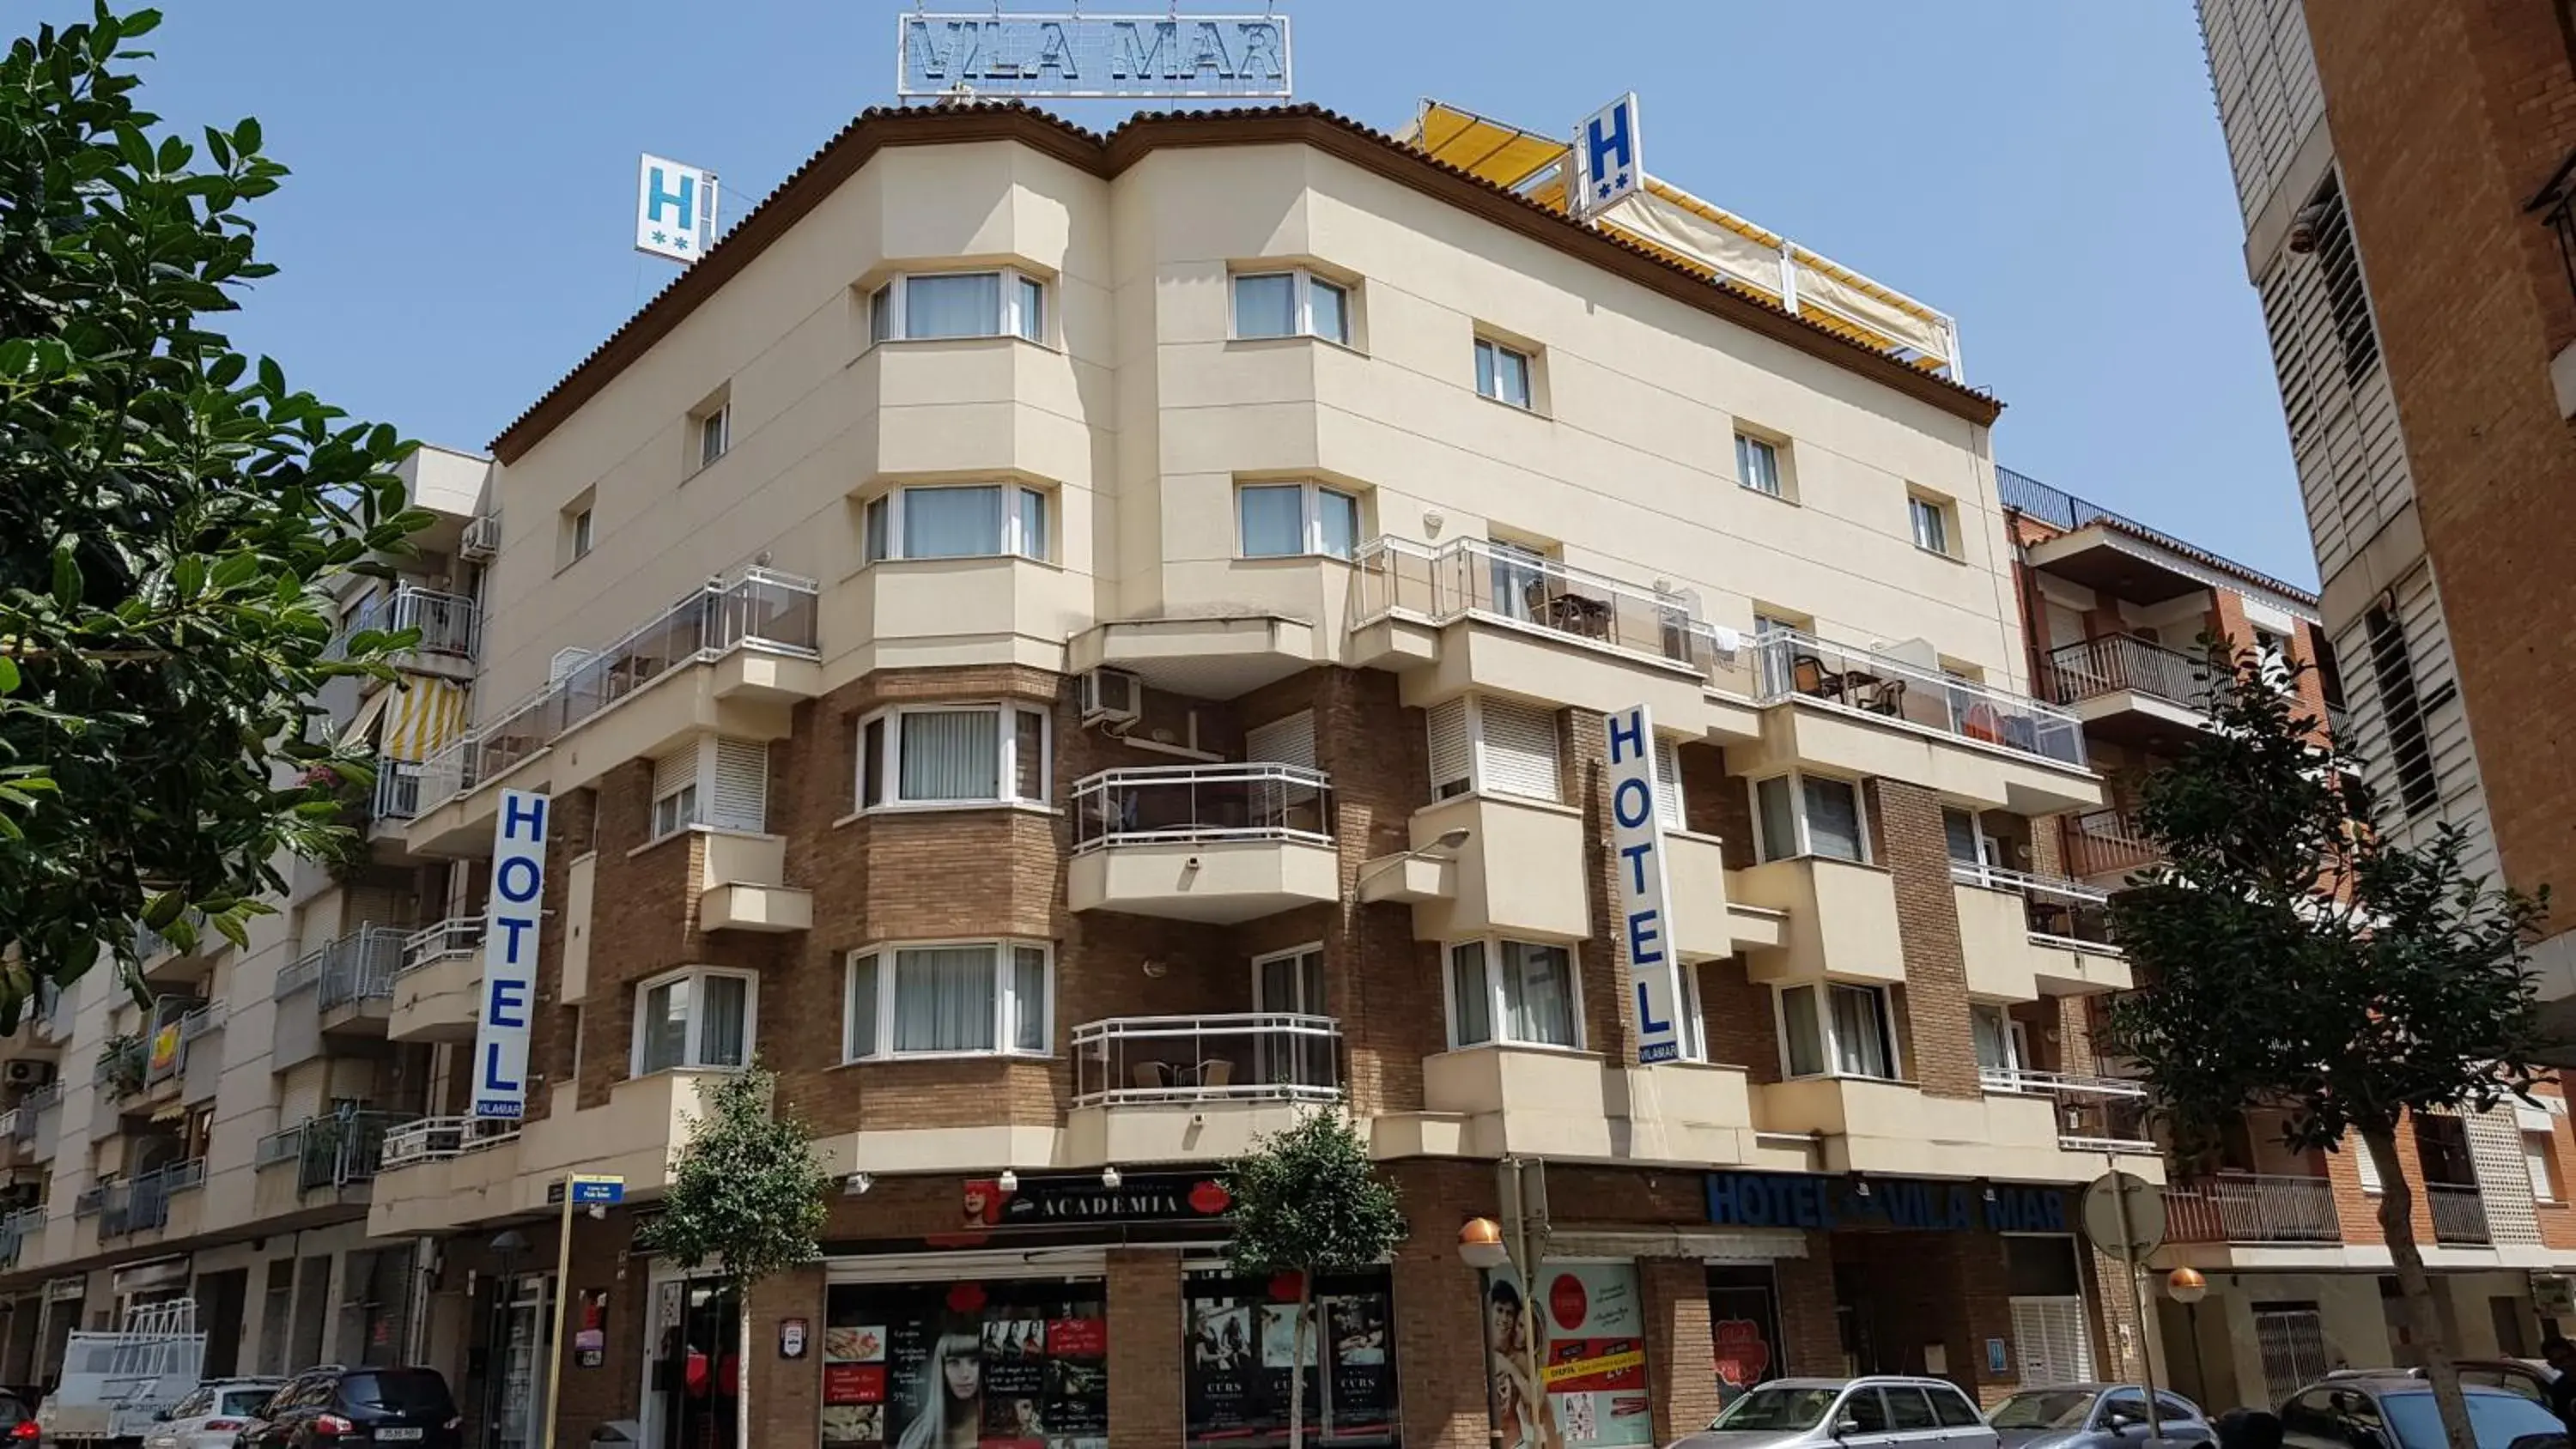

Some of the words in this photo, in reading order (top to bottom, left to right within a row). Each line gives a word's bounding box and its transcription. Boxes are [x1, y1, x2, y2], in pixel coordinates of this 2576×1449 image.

[911, 21, 1078, 80] VILA
[1112, 21, 1282, 80] MAR
[1588, 101, 1631, 184] H
[647, 166, 695, 231] H
[1609, 711, 1670, 1034] HOTEL
[485, 796, 544, 1091] HOTEL
[1707, 1173, 1838, 1228] HOTEL
[1884, 1181, 1970, 1228] VILA
[1984, 1187, 2067, 1230] MAR
